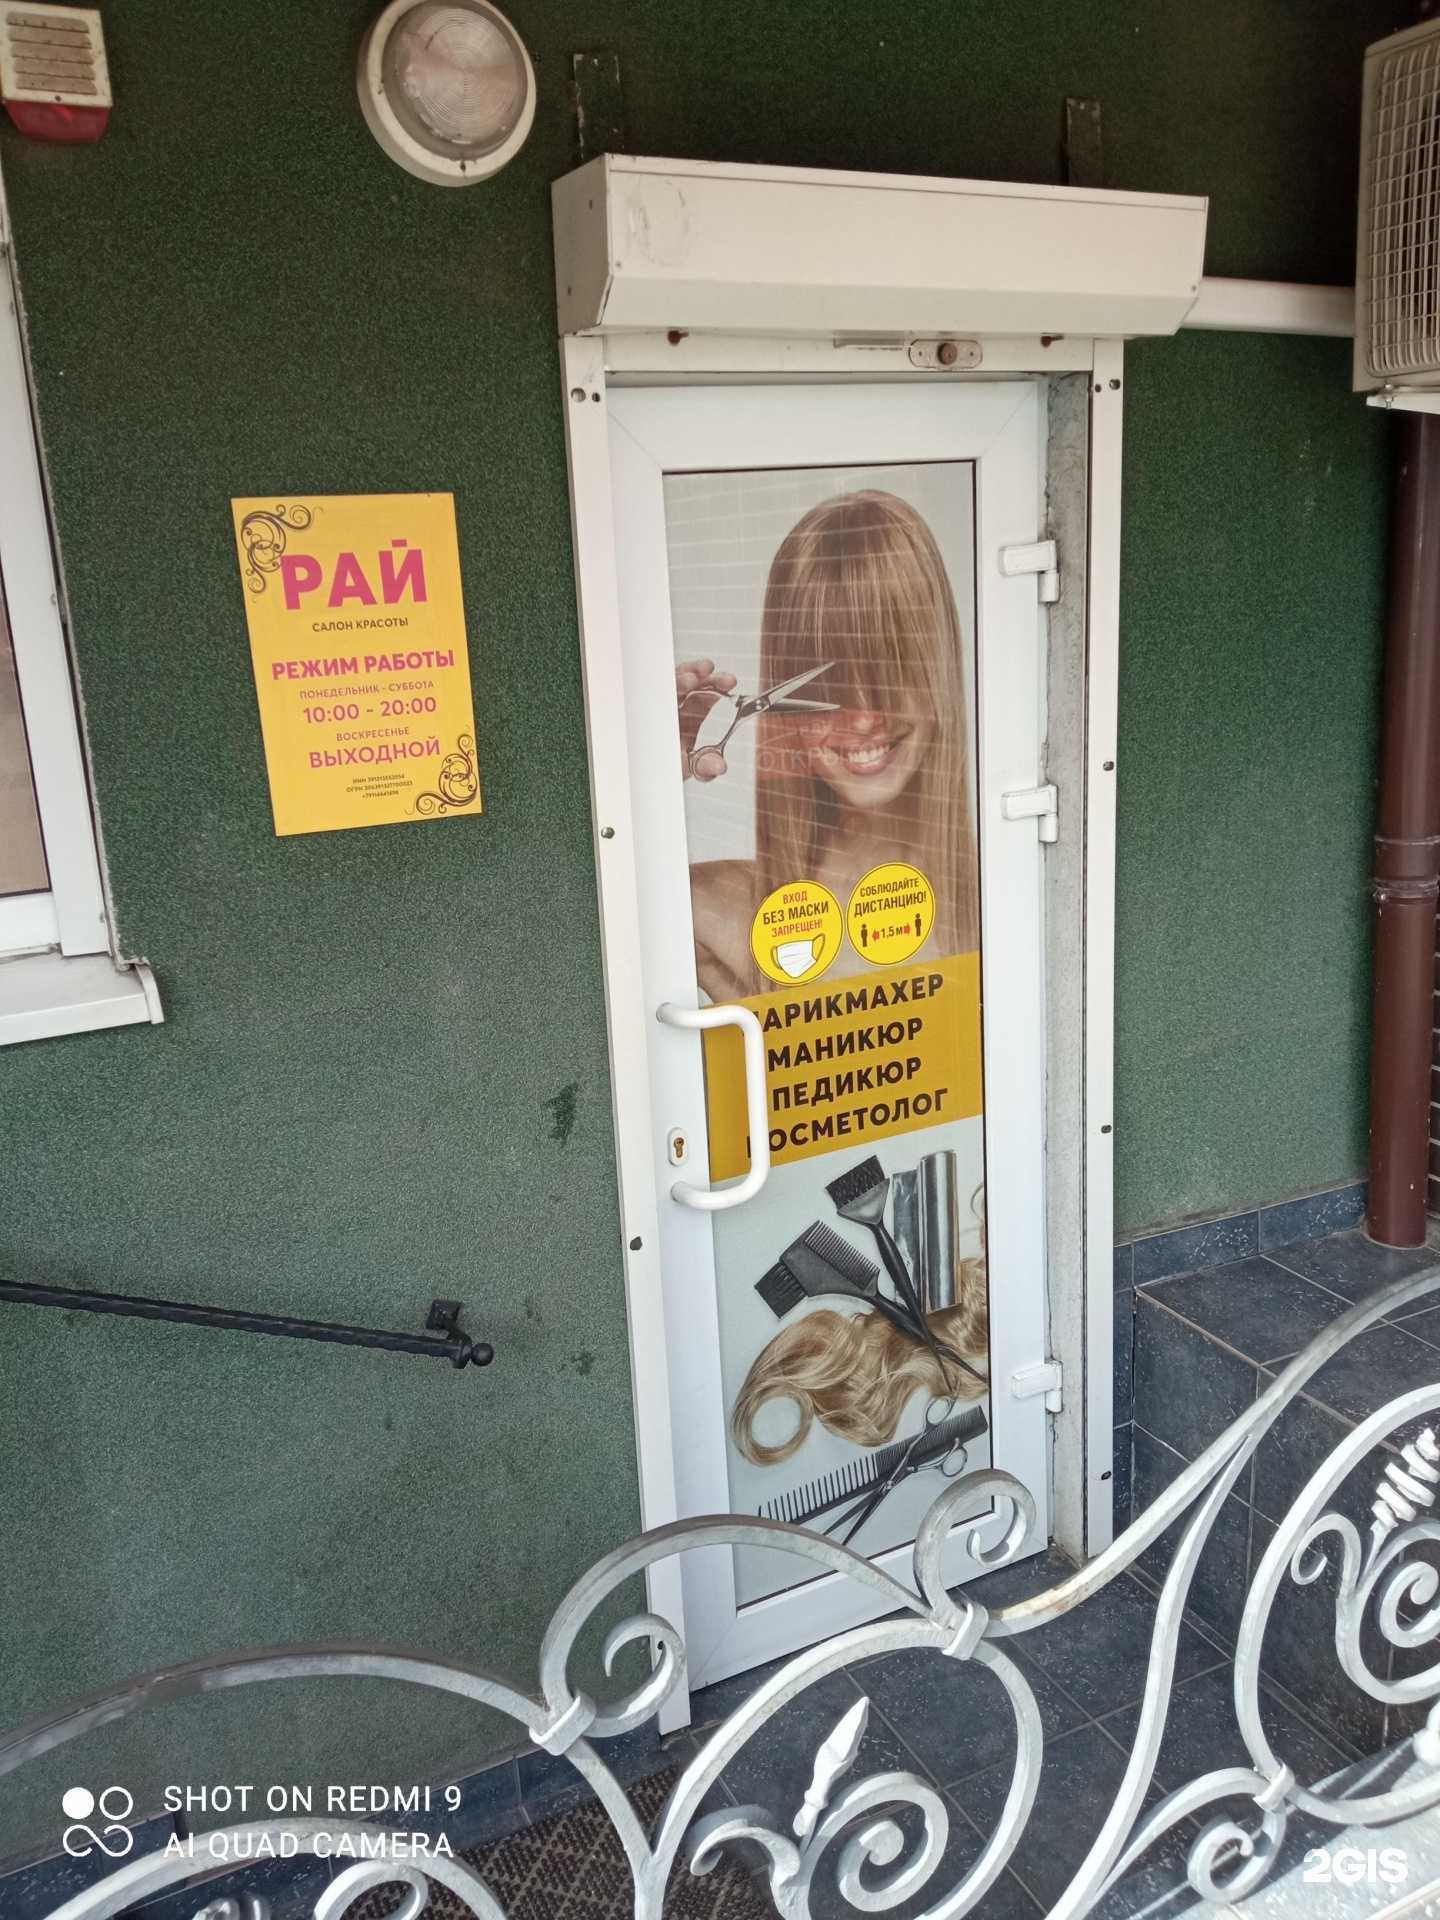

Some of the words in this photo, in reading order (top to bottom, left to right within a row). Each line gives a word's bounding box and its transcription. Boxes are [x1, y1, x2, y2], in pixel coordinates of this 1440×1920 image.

[280, 539, 428, 611] РАЙ
[312, 621, 353, 633] САЛОН
[356, 617, 409, 630] КРАСОТЫ
[271, 656, 359, 681] РЕЖИМ
[364, 650, 455, 673] РАБОТЫ
[300, 685, 380, 700] ПОНЕДЕЛЬНИК
[388, 680, 434, 692] СУББОТА
[303, 704, 360, 724] 10:00
[380, 697, 437, 717] 20:00
[336, 726, 410, 742] ВОСКРЕСЕНЬЕ
[309, 736, 441, 769] ВЫХОДНОЙ
[782, 890, 808, 905] ВХОД
[859, 877, 920, 898] СОБЛЮДАЙТЕ
[763, 909, 785, 926] БЕЗ
[788, 901, 829, 920] МАСКИ
[854, 890, 927, 919] ДИСТАНЦИЮ!
[771, 919, 823, 939] ЗАПРЕЩЕН!
[881, 927, 895, 940] 1,5
[750, 973, 944, 1034] АРИКМАХЕР
[767, 1017, 924, 1073] МАНИКЮР
[772, 1056, 922, 1112] ПЕДИКЮР
[746, 1088, 949, 1159] ОСМЕТОЛОГ
